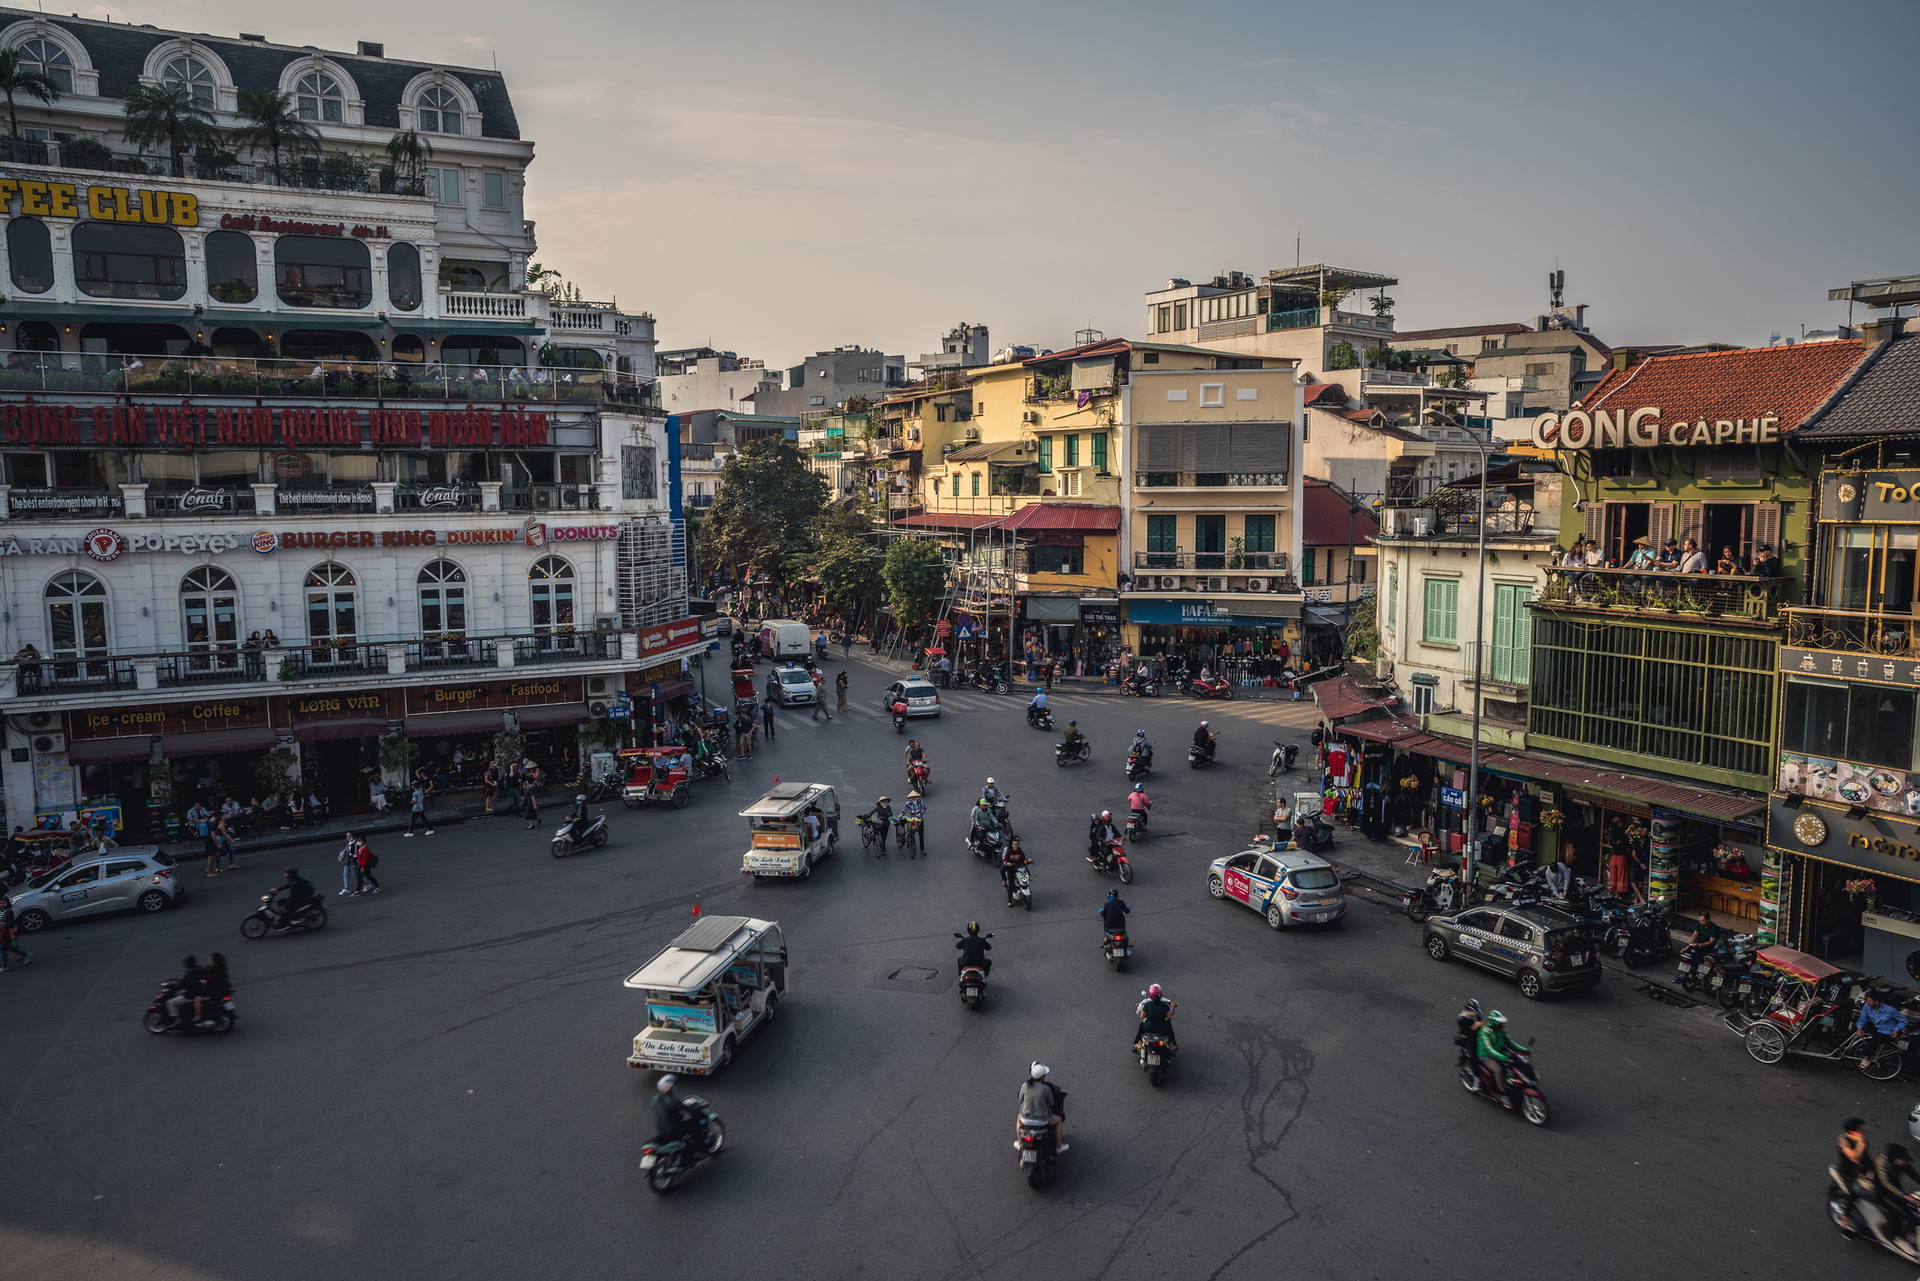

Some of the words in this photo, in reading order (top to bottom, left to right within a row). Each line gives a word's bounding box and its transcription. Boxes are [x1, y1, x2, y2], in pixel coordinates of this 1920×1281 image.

[87, 185, 199, 227] CLUB
[259, 215, 345, 237] Restaurant
[216, 407, 274, 444] NAM
[279, 408, 361, 448] QUANG
[368, 408, 422, 445] VINH
[428, 404, 493, 445] MUÔN
[85, 528, 122, 544] LOUISIANA
[252, 533, 275, 543] BURGER
[253, 538, 276, 550] KING
[282, 531, 375, 549] BURGER
[382, 529, 436, 547] KING
[447, 529, 519, 545] DUNKIN'
[554, 525, 619, 541] DONUTS
[1181, 604, 1211, 617] HAFA
[435, 688, 478, 704] Burger
[511, 681, 560, 697] Fastfood
[88, 713, 110, 727] Ice
[123, 710, 166, 725] cream
[192, 703, 241, 719] Coffee
[299, 699, 341, 712] LONG
